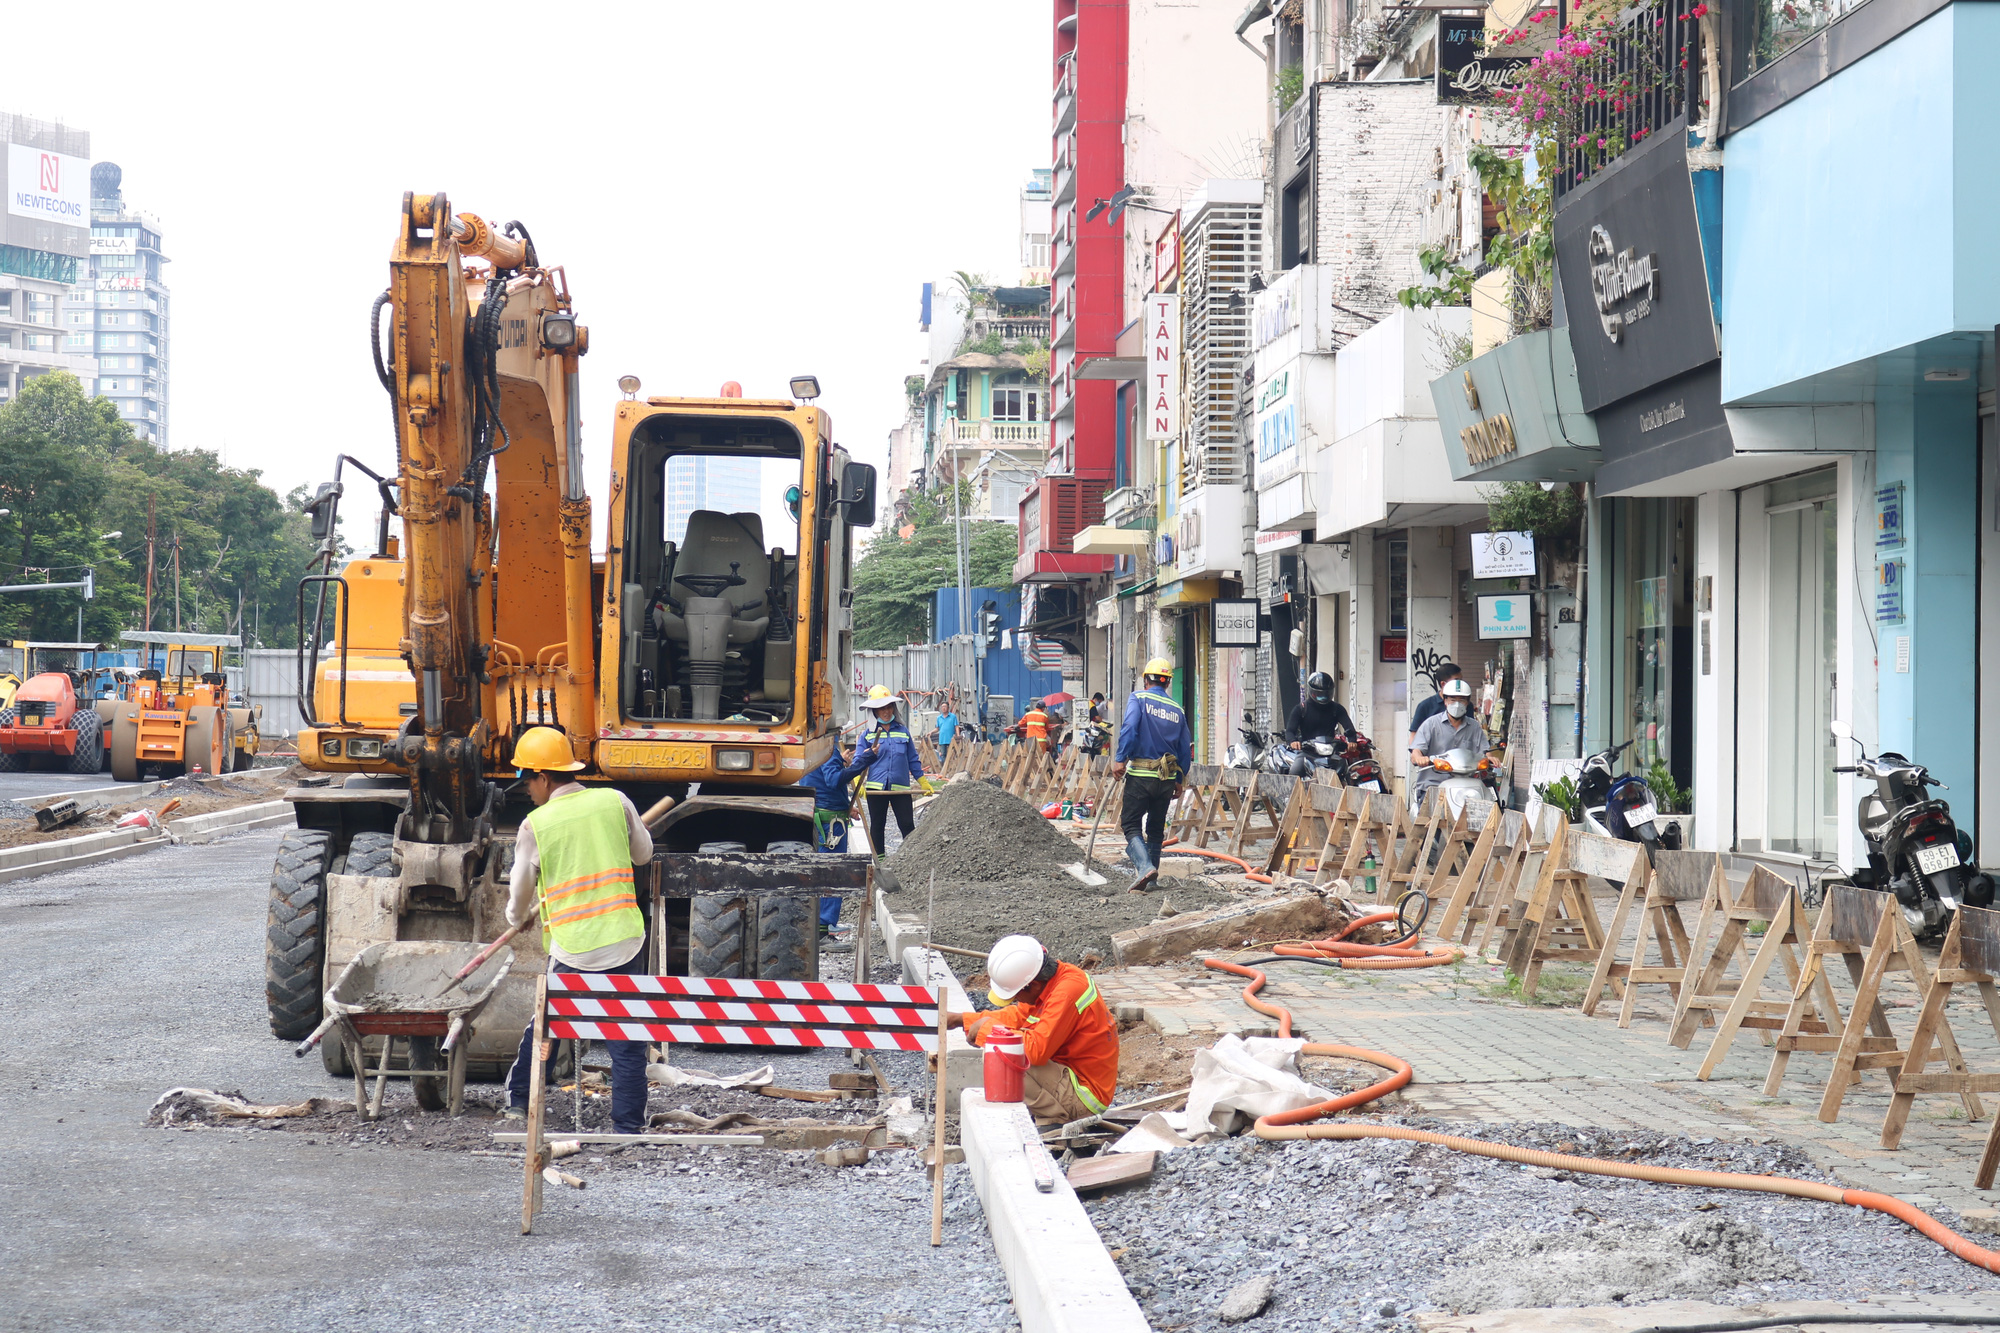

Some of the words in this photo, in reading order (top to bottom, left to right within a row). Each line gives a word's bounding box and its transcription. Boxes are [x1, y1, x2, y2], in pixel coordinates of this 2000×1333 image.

[1446, 29, 1468, 45] Mỹ
[17, 192, 81, 216] NEWTECONS
[118, 277, 141, 287] ONE
[1155, 303, 1170, 361] TÂN
[1155, 374, 1170, 432] TÂN
[1923, 847, 1949, 862] 59-E1
[1924, 856, 1957, 872] 958.72
